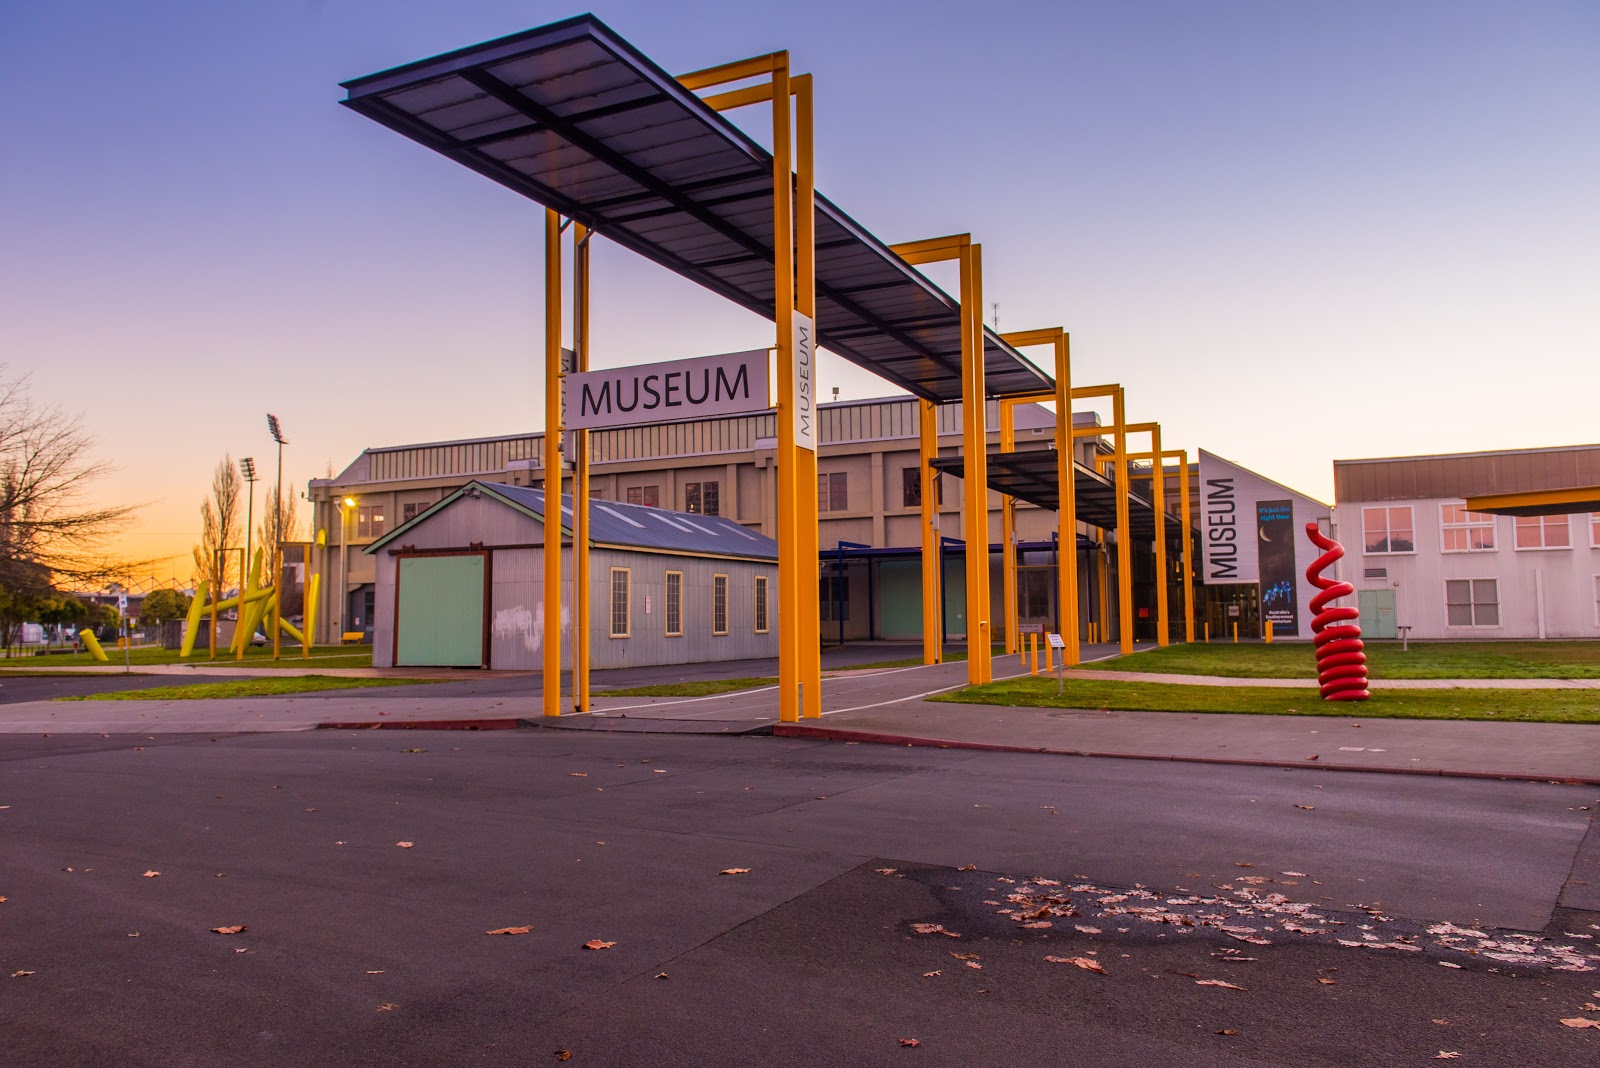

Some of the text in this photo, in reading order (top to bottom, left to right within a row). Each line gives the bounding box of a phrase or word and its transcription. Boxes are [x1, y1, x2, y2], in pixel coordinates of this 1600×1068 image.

[580, 363, 750, 417] MUSEUM
[798, 326, 810, 437] MUSEUM
[1206, 478, 1238, 578] MUSEUM
